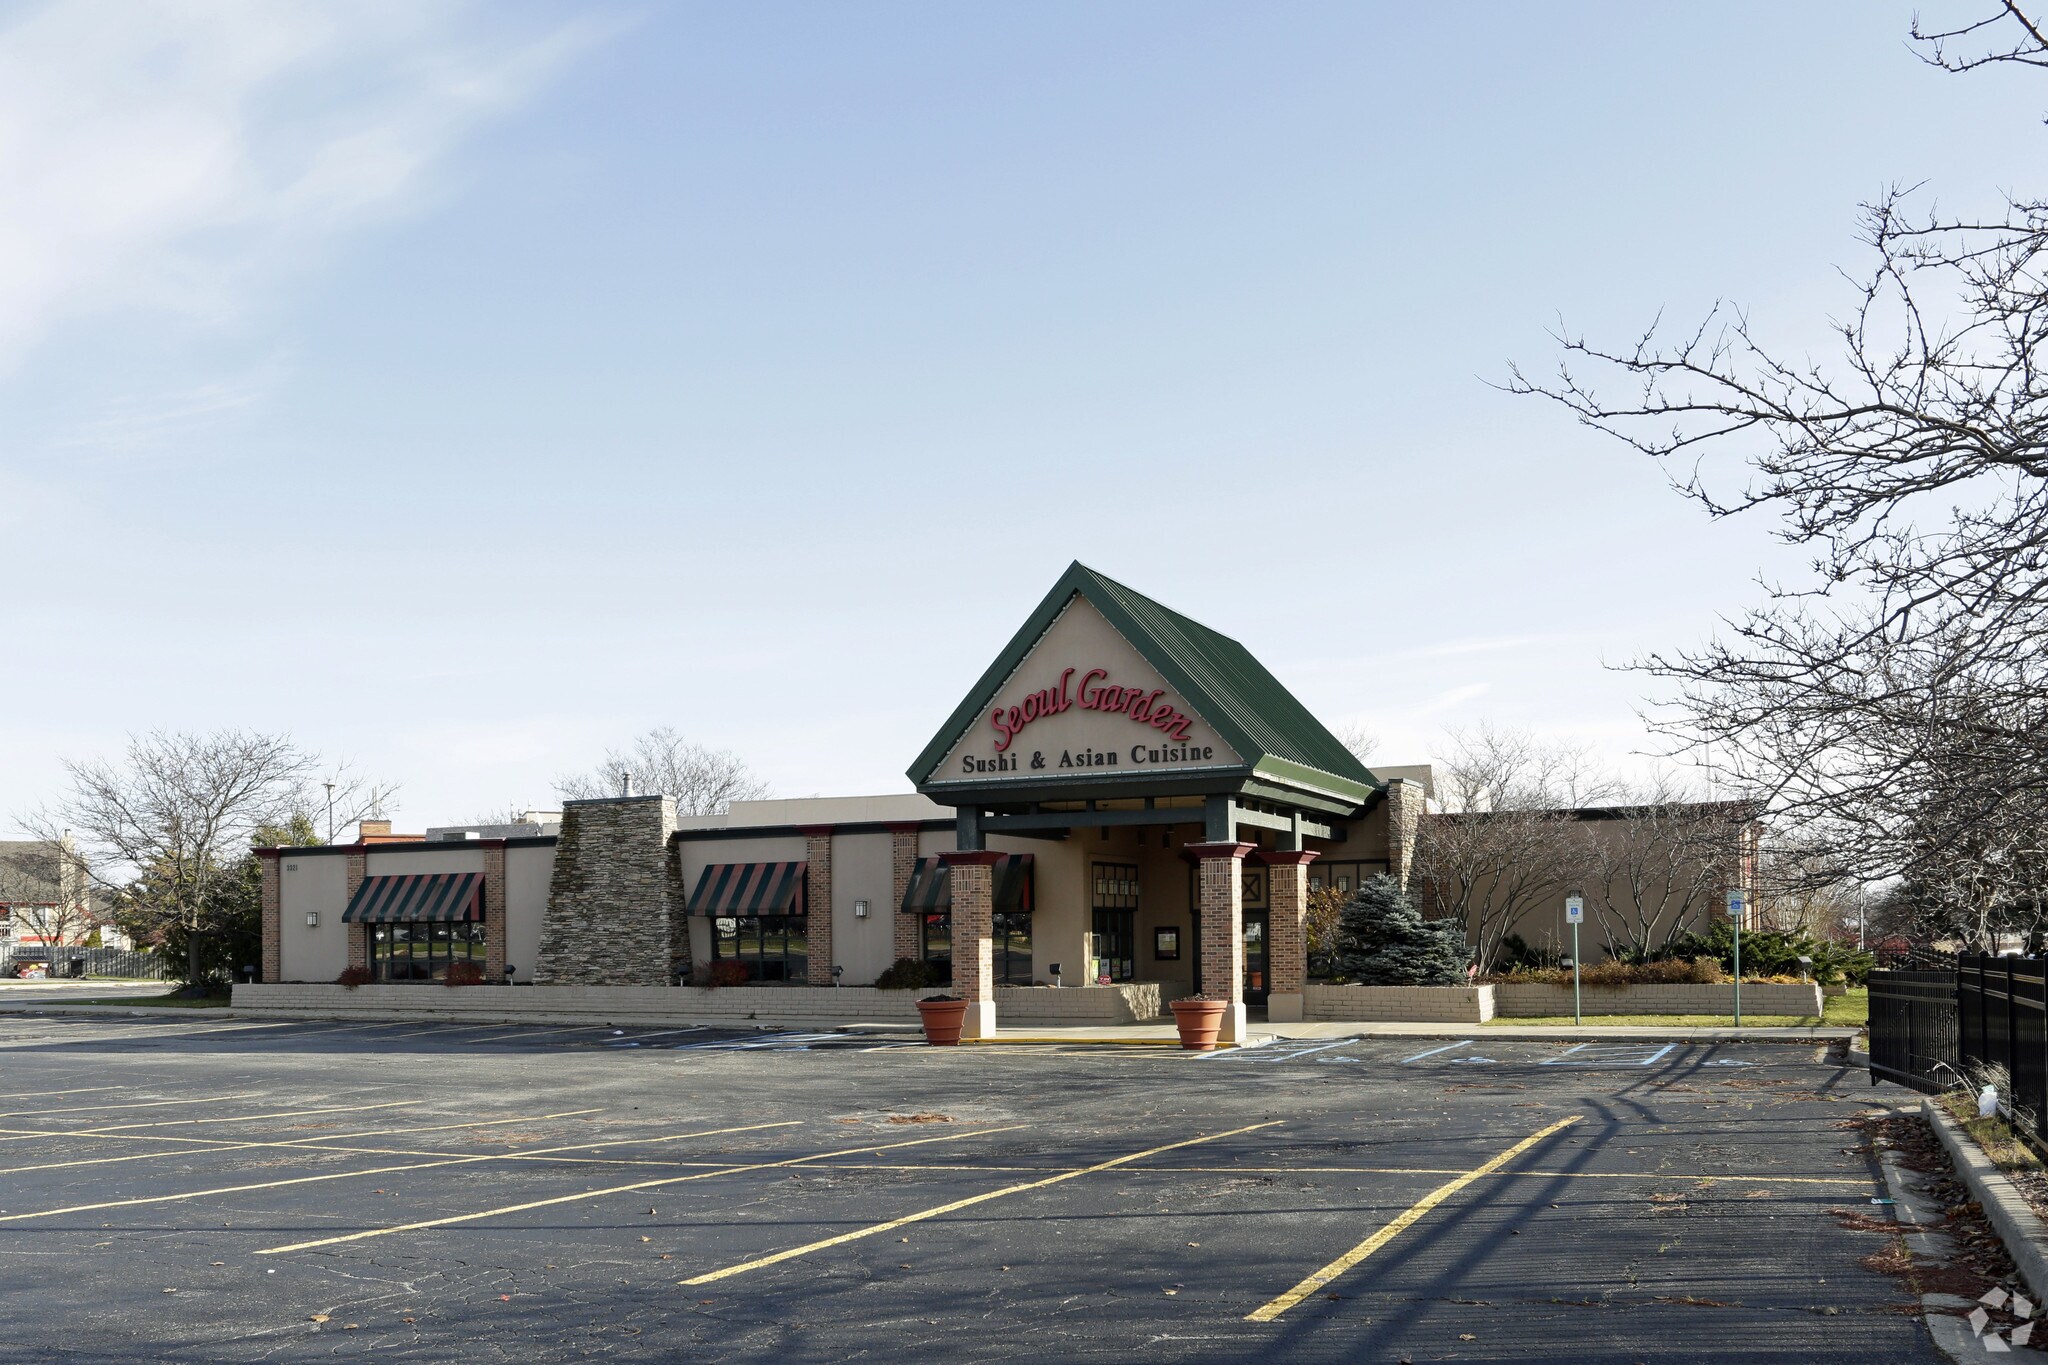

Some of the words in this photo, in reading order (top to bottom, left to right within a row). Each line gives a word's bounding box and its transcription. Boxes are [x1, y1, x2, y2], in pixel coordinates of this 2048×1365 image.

[991, 667, 1075, 751] Seoul
[1076, 668, 1192, 741] Garden
[962, 752, 1017, 773] Sushi
[1030, 751, 1046, 769] &
[1059, 748, 1118, 768] Asian
[1131, 742, 1213, 764] Cuisine
